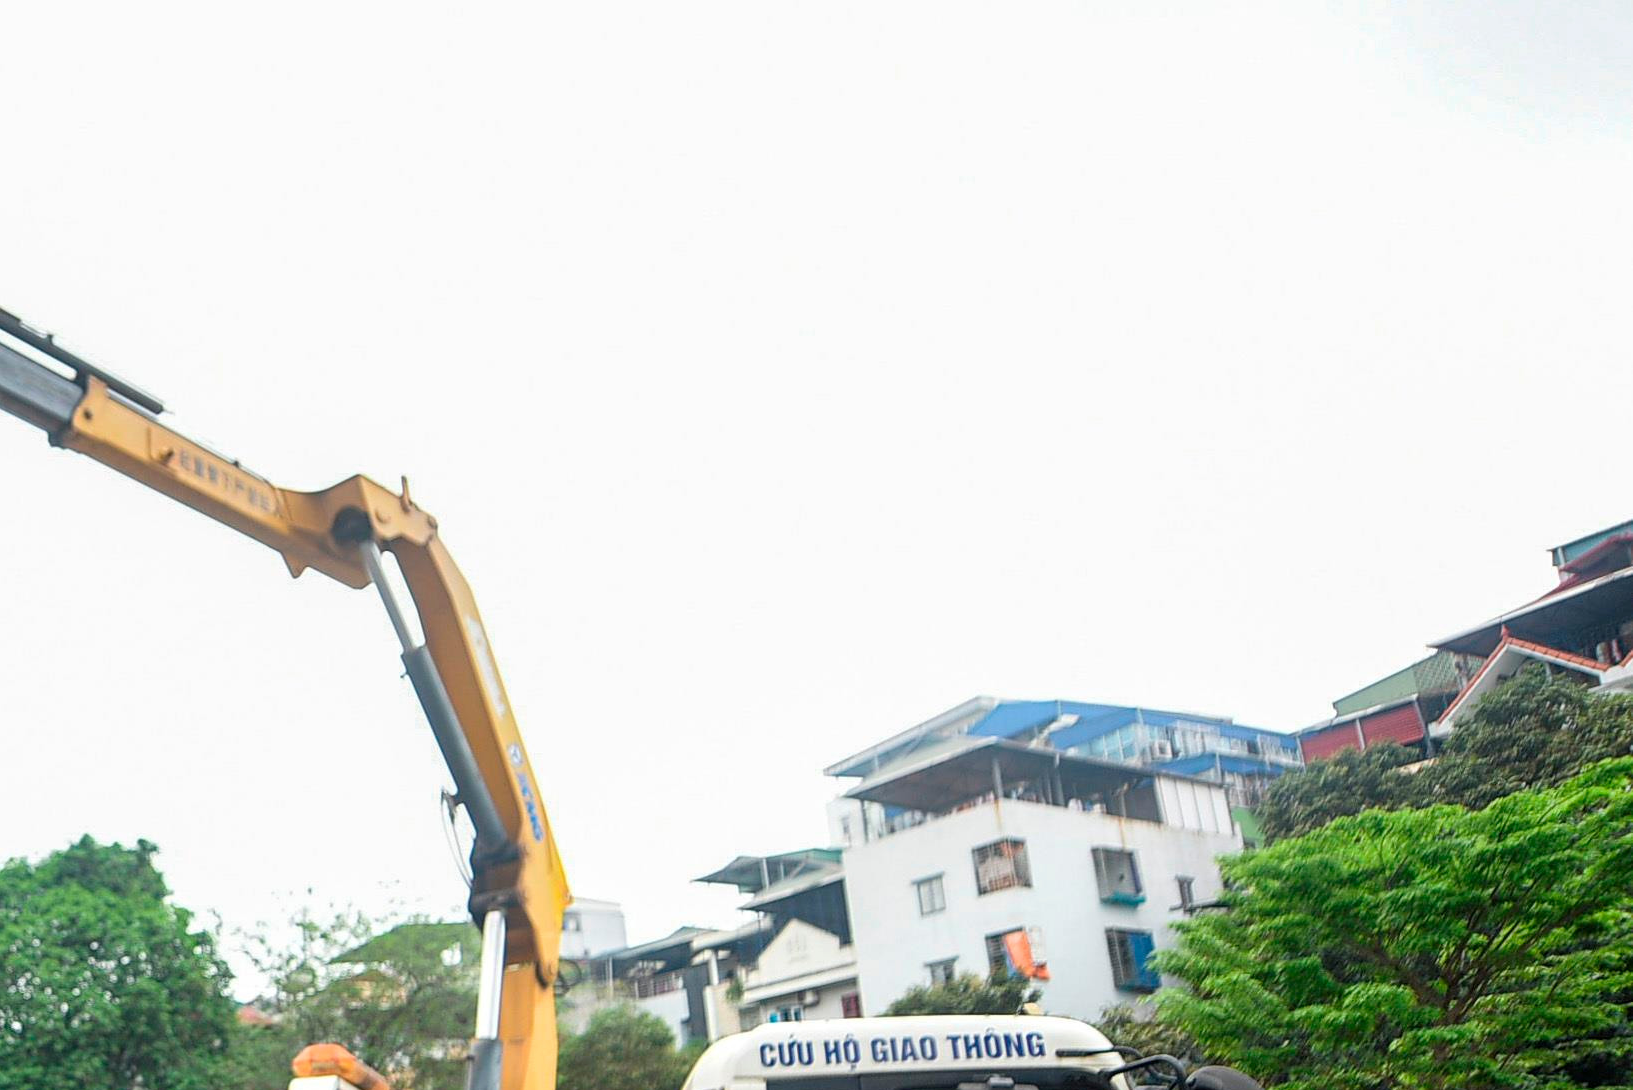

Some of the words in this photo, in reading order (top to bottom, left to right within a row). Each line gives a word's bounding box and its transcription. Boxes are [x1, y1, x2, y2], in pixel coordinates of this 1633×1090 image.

[759, 1033, 815, 1067] CỨU
[824, 1033, 861, 1070] HỘ
[870, 1034, 938, 1063] GIAO
[946, 1027, 1046, 1060] THÔNG
